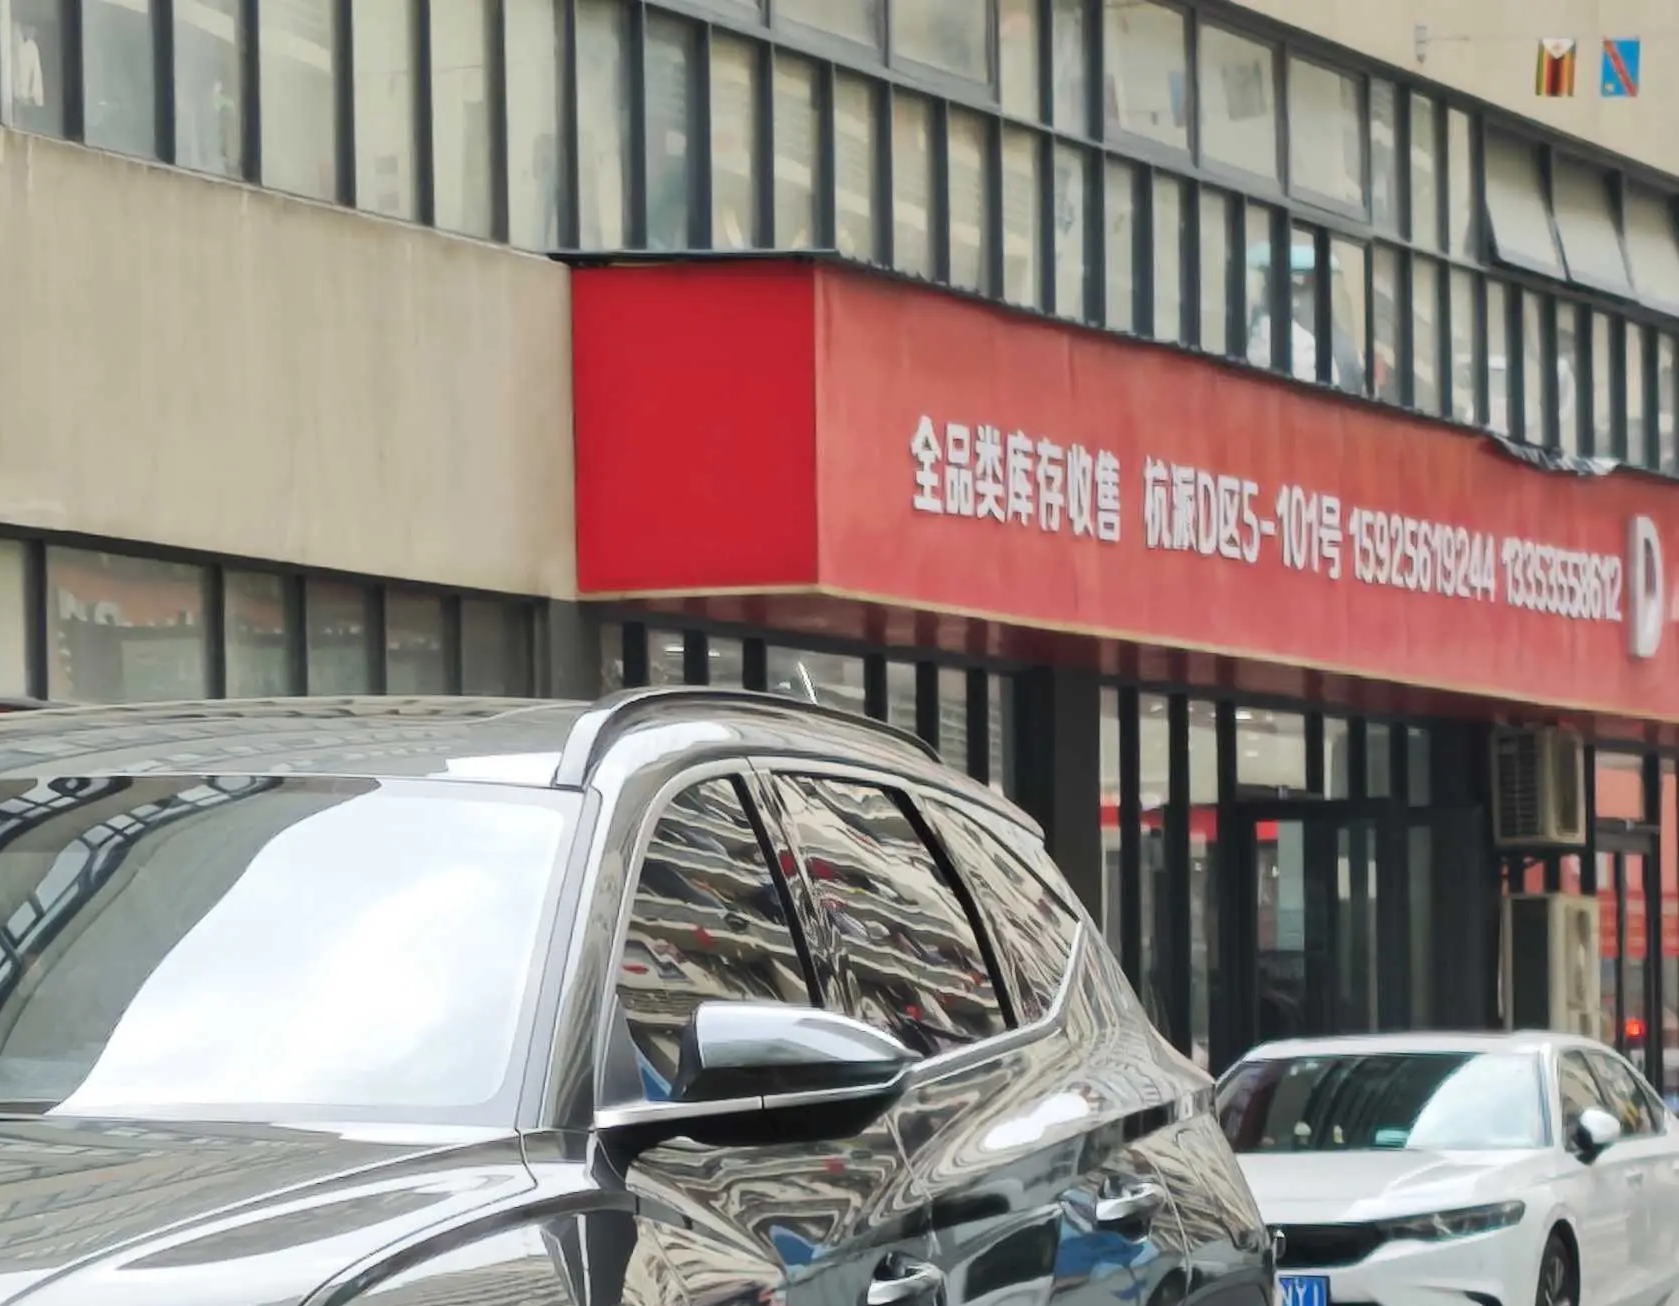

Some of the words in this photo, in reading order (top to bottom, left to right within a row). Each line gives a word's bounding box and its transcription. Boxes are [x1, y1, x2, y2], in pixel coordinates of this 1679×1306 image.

[911, 414, 1121, 543] 全品类库存收售
[1349, 506, 1496, 604] 15925619244
